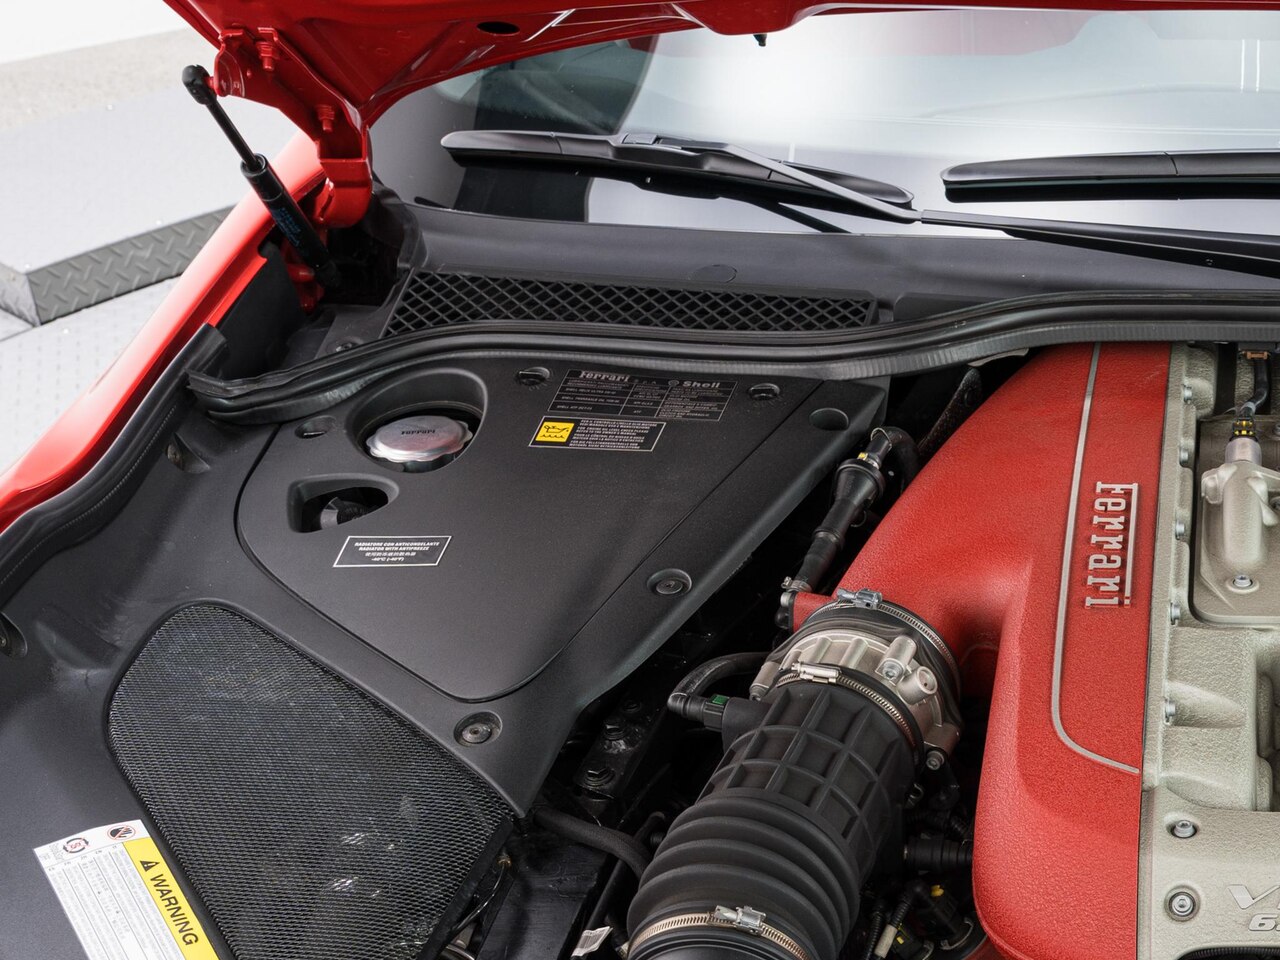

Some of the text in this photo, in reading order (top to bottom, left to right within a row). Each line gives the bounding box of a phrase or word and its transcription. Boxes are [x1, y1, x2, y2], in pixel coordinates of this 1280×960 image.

[578, 370, 631, 383] Ferrari
[682, 380, 721, 389] Shell
[1085, 481, 1138, 607] Ferrari
[150, 873, 199, 946] WARNING
